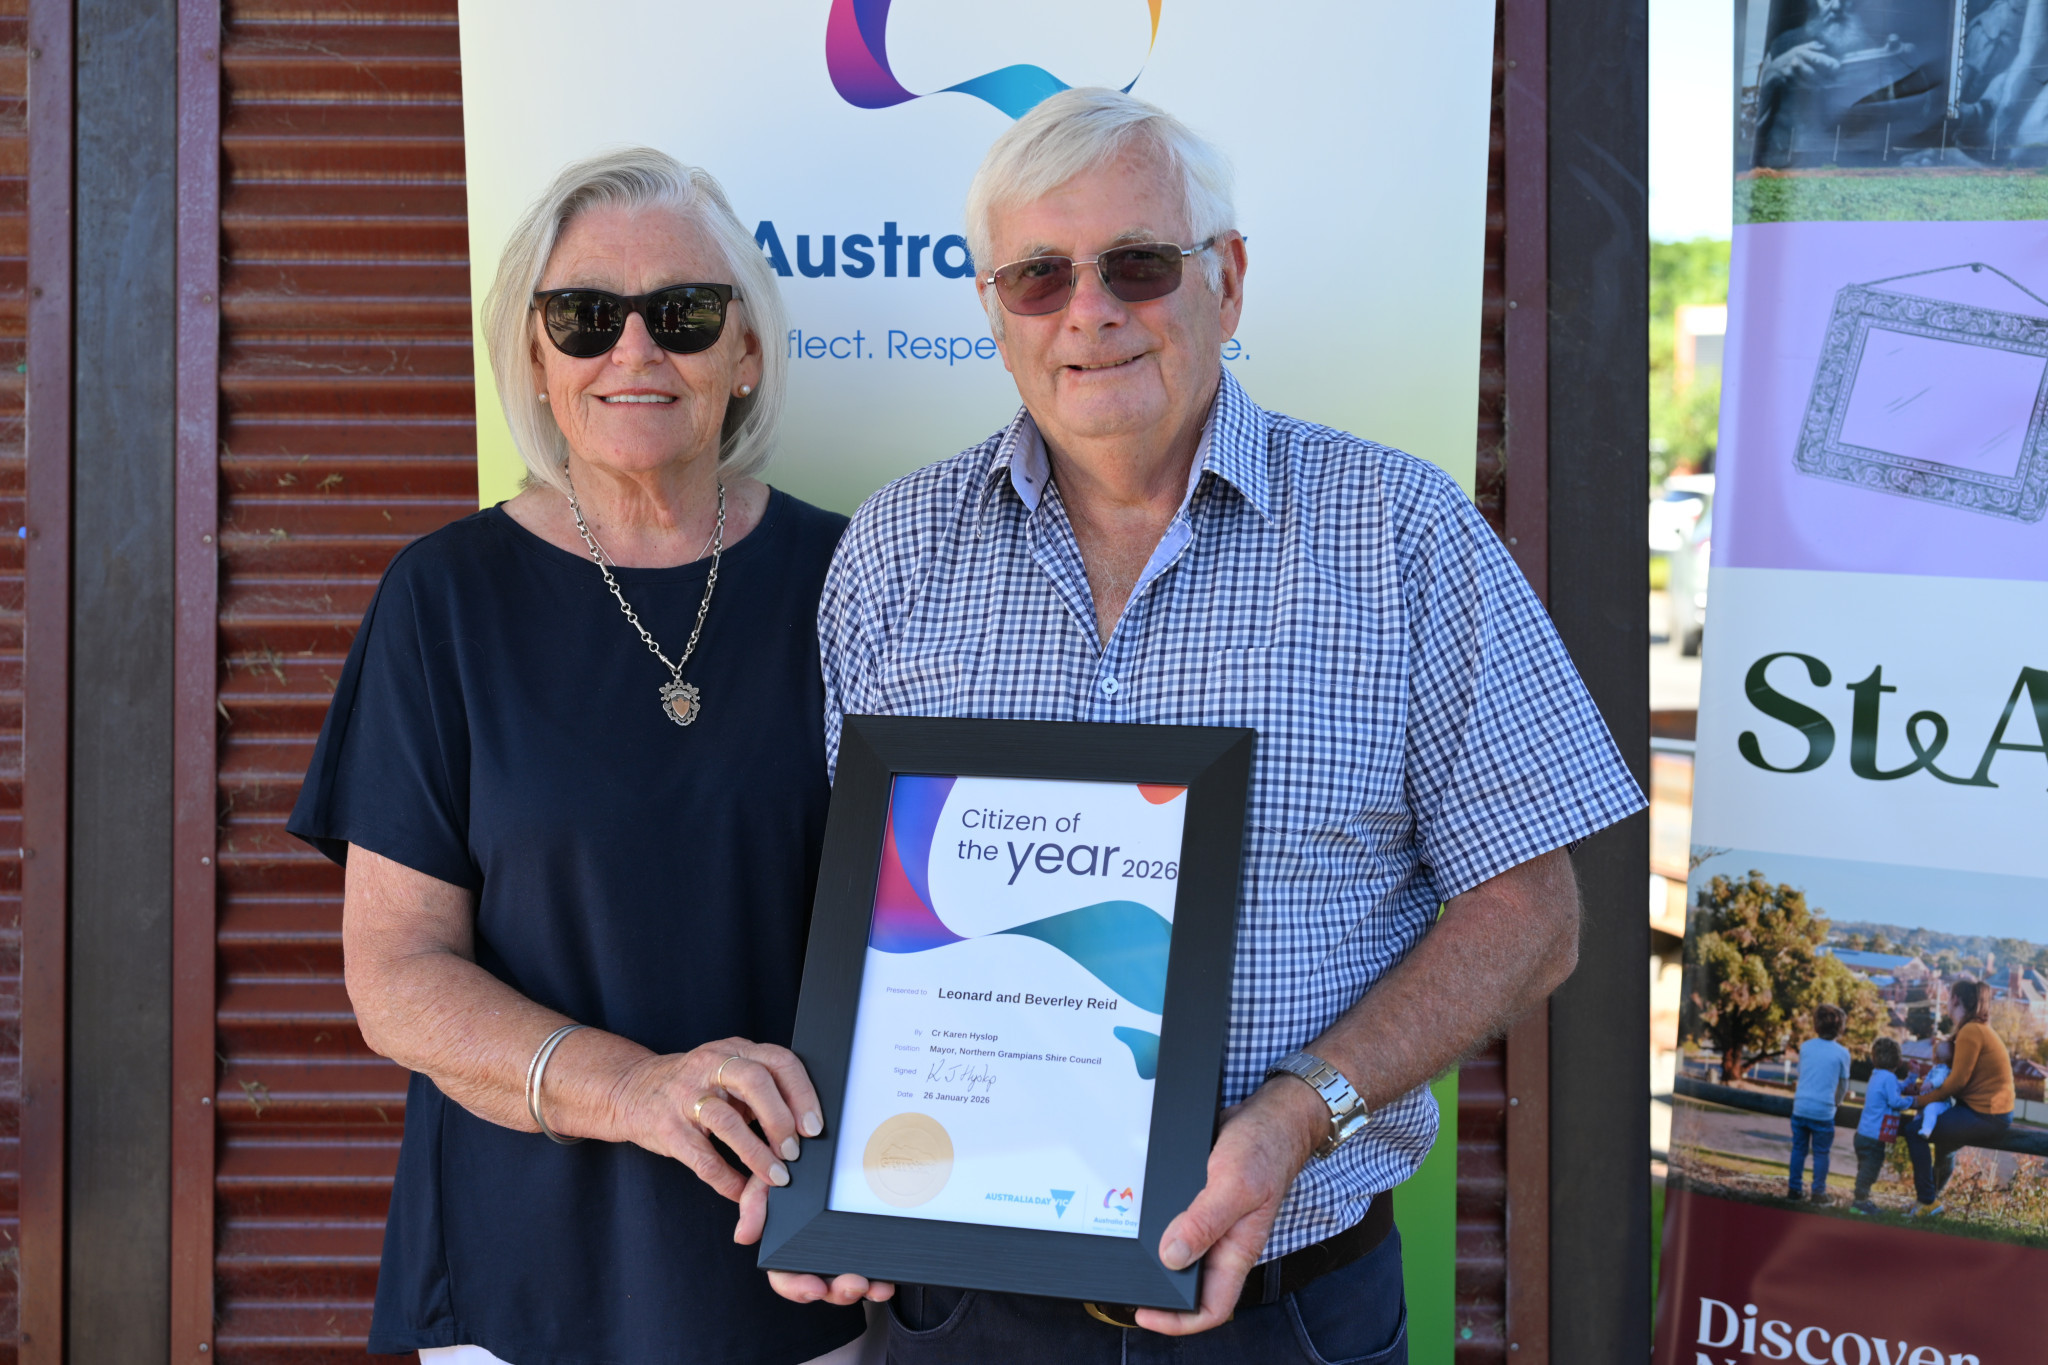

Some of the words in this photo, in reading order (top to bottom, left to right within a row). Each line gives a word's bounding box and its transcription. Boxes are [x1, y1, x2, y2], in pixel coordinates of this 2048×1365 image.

[754, 220, 977, 279] Austra
[788, 329, 873, 359] flect.
[888, 329, 997, 366] Respe
[962, 808, 1047, 831] Citizen
[1055, 812, 1081, 833] of
[958, 839, 998, 861] the
[1007, 841, 1120, 885] year
[1121, 859, 1178, 880] 2026
[886, 986, 919, 995] Presented
[920, 988, 927, 996] to
[938, 988, 992, 1002] Leonard
[996, 992, 1021, 1004] and
[1024, 993, 1083, 1011] Beverley
[1087, 998, 1118, 1010] Reid
[931, 1029, 941, 1037] Cr
[943, 1030, 967, 1039] Karen
[969, 1032, 998, 1042] Hyslop
[894, 1044, 920, 1052] Position
[929, 1045, 957, 1055] Mayor,
[959, 1048, 996, 1057] Northern
[998, 1050, 1043, 1061] Grampians
[1045, 1053, 1067, 1062] Shire
[1069, 1055, 1102, 1065] Council
[893, 1067, 917, 1075] Signed
[897, 1090, 914, 1098] Date
[923, 1091, 934, 1100] 26
[935, 1093, 969, 1104] January
[970, 1095, 990, 1104] 2026
[985, 1192, 1034, 1204] AUSTRALIA
[1034, 1197, 1052, 1206] DAY
[1093, 1217, 1123, 1226] Australia
